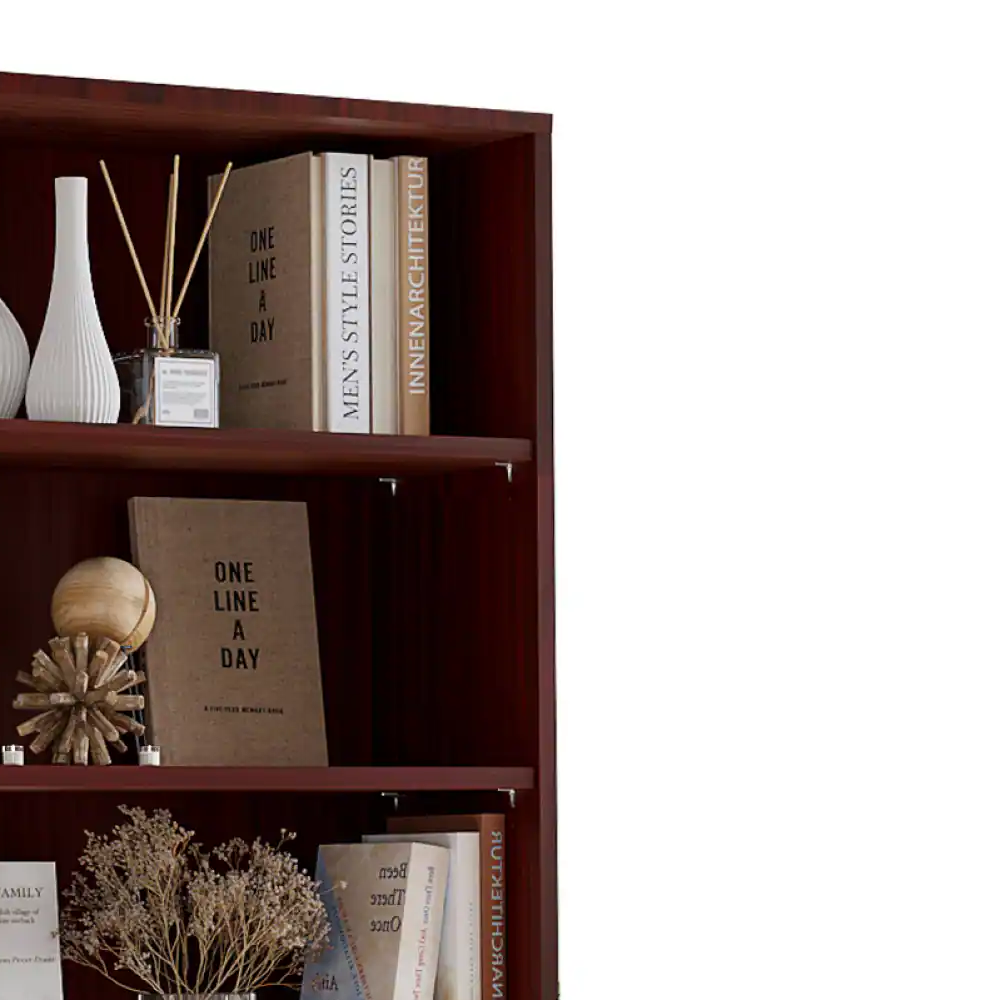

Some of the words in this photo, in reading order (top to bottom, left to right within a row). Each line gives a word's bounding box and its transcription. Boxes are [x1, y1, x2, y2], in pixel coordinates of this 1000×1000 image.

[340, 166, 358, 264] STORIES
[250, 226, 275, 252] ONE
[248, 257, 277, 284] LINE
[408, 156, 426, 395] INNENARCHITEKTUR
[258, 290, 267, 312] A
[341, 271, 359, 345] STYLE
[250, 317, 275, 345] DAY
[342, 349, 360, 420] MEN'S
[214, 561, 254, 583] ONE
[213, 590, 259, 612] LINE
[232, 620, 245, 641] A
[220, 648, 260, 670] DAY
